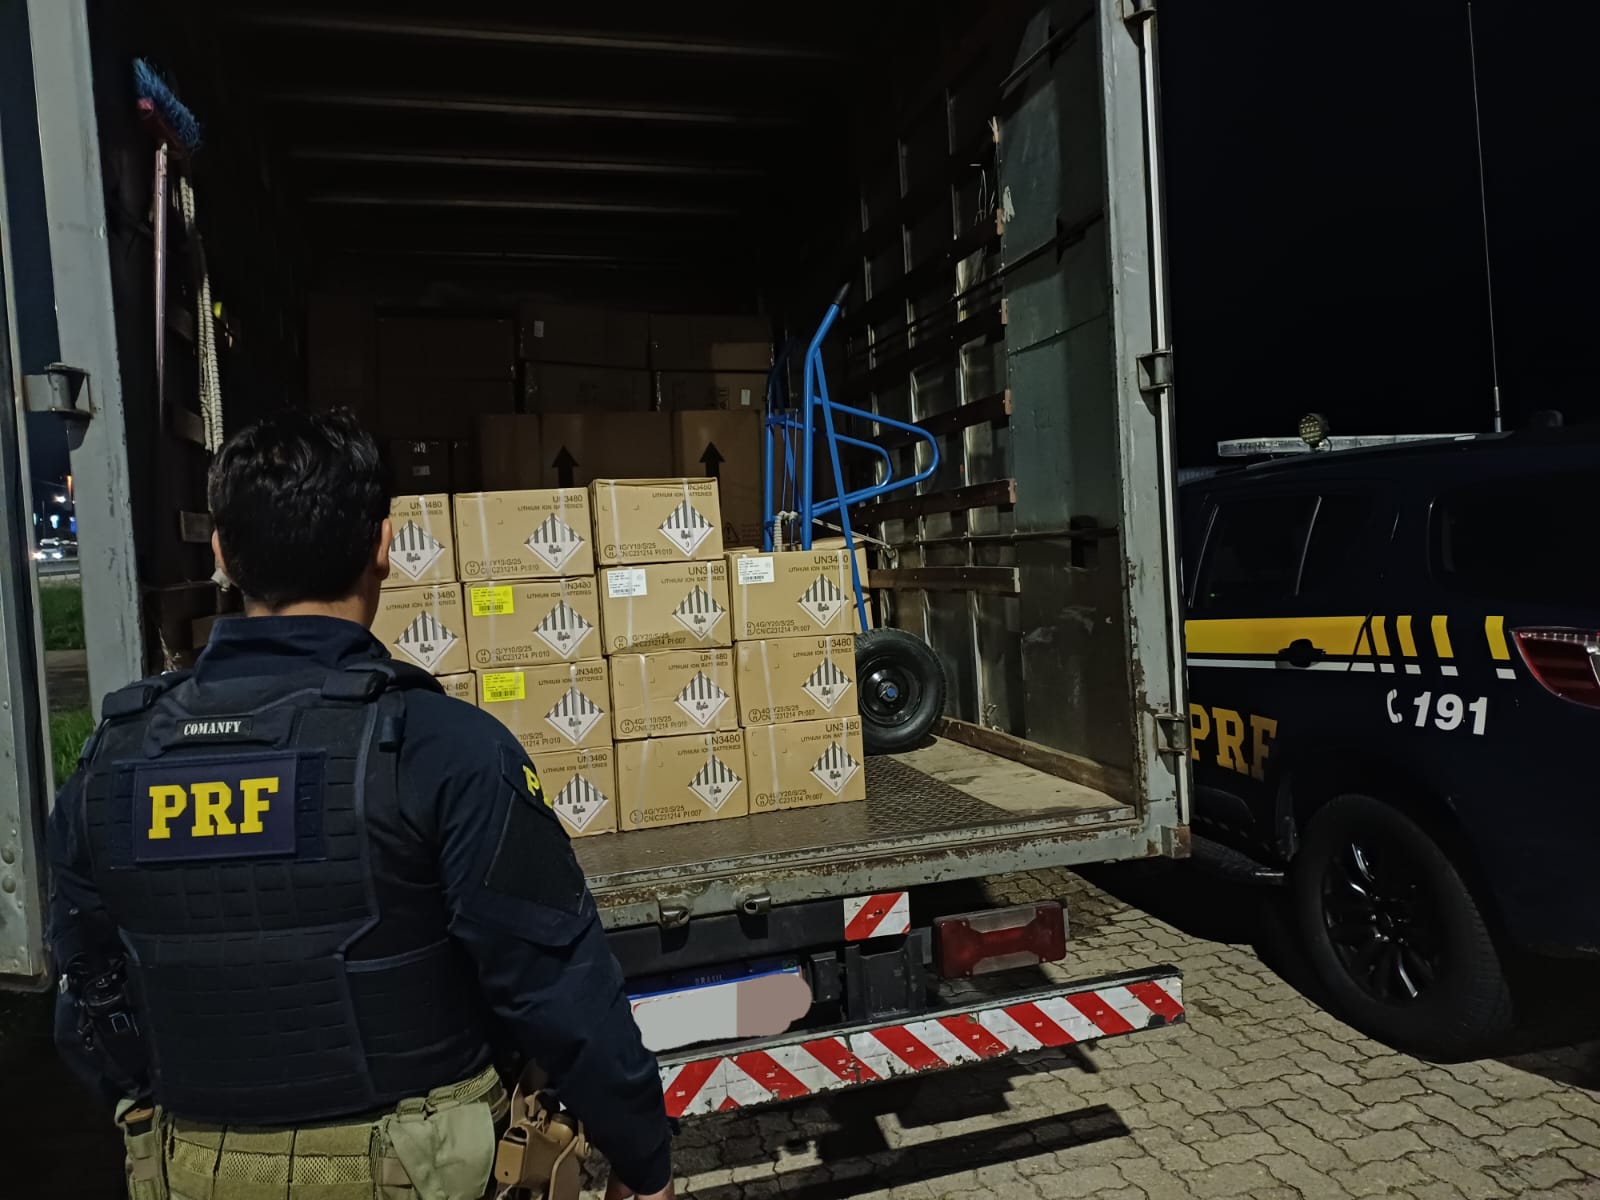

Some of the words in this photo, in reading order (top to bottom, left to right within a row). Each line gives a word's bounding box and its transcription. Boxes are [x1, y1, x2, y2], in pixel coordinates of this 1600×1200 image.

[552, 494, 583, 503] U3480
[409, 501, 443, 510] UN480
[814, 554, 849, 564] UN340
[817, 638, 852, 648] U3480
[700, 653, 728, 662] UN480
[1413, 691, 1488, 736] 191
[183, 720, 242, 736] COMANFY
[1188, 702, 1278, 782] PRF
[148, 776, 279, 840] PRF
